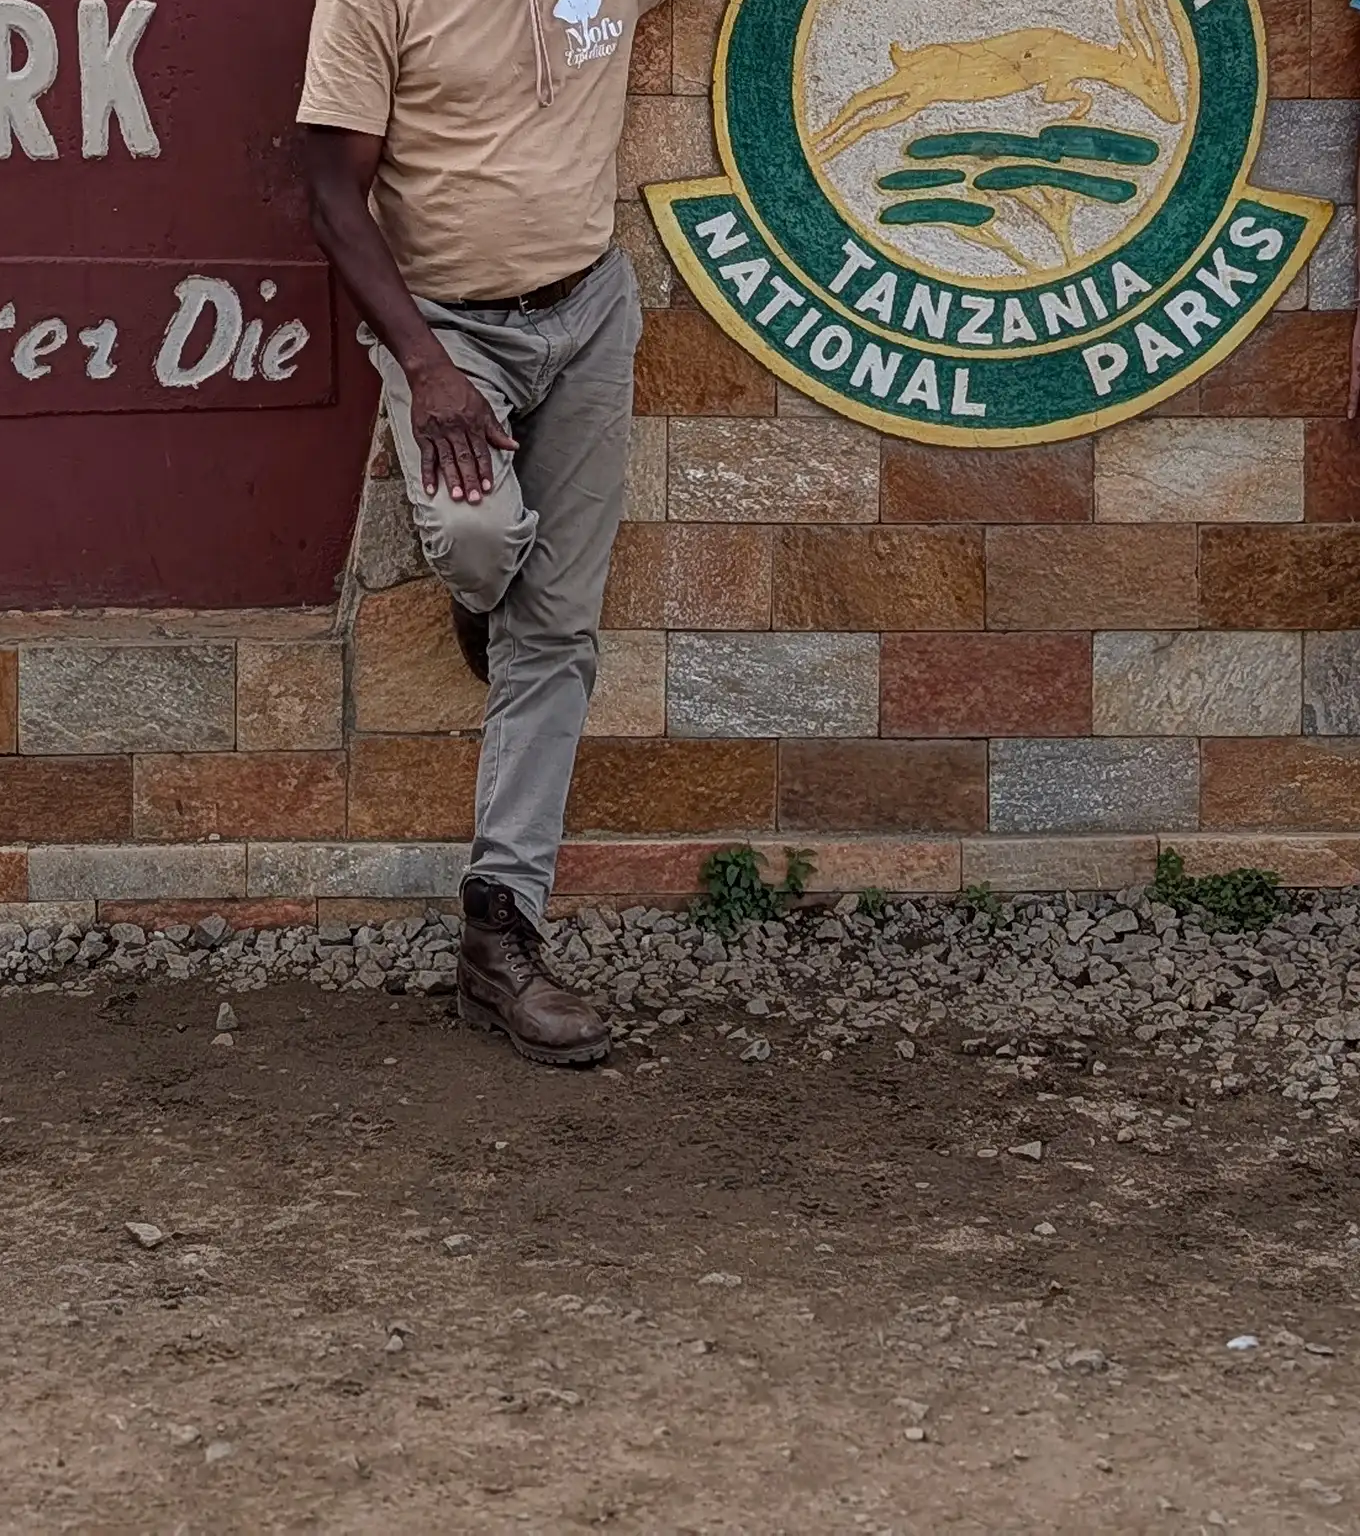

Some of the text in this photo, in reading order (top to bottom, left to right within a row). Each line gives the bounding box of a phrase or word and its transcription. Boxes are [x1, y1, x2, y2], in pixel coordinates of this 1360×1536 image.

[153, 275, 311, 389] Die
[693, 210, 1284, 417] NATIONAL PARKS
[826, 237, 1152, 345] TANZANIA
